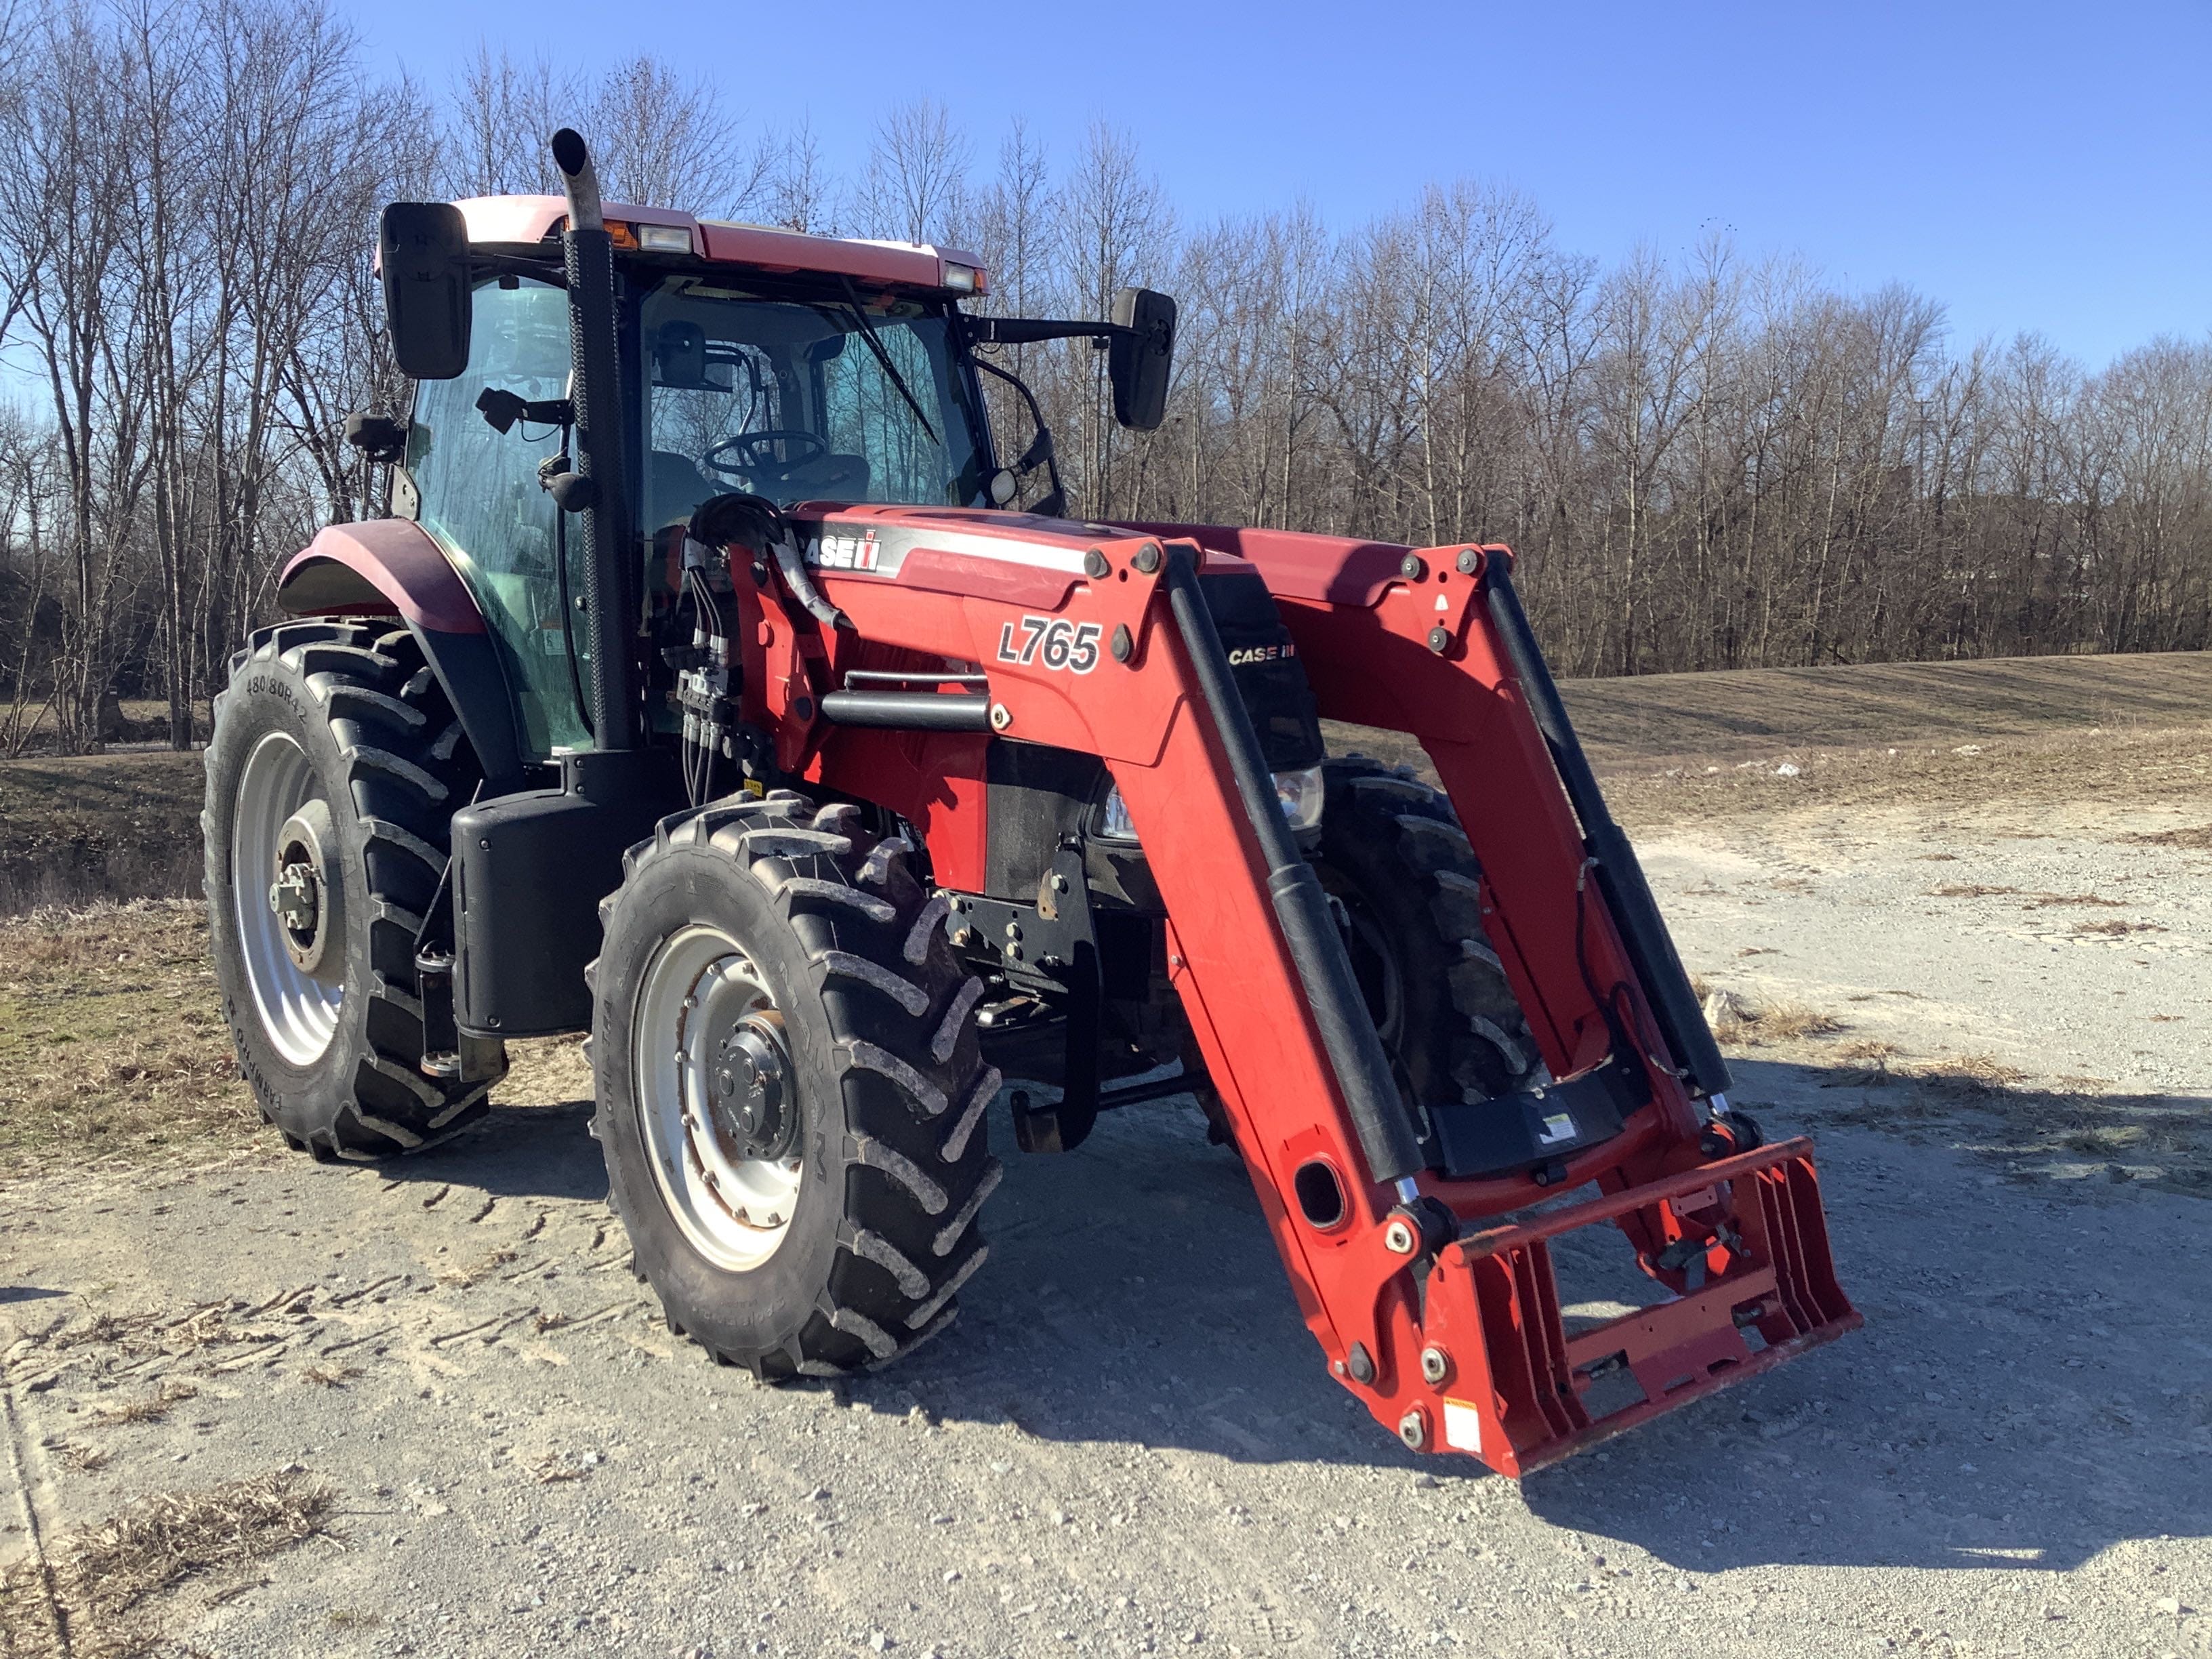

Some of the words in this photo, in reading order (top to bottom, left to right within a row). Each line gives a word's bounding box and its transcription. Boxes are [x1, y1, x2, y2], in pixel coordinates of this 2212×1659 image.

[802, 535, 856, 568] ASE
[997, 614, 1103, 676] L765
[1228, 646, 1277, 665] CASE
[246, 675, 307, 724] 480/80R42
[237, 1027, 282, 1111] FARMPRO
